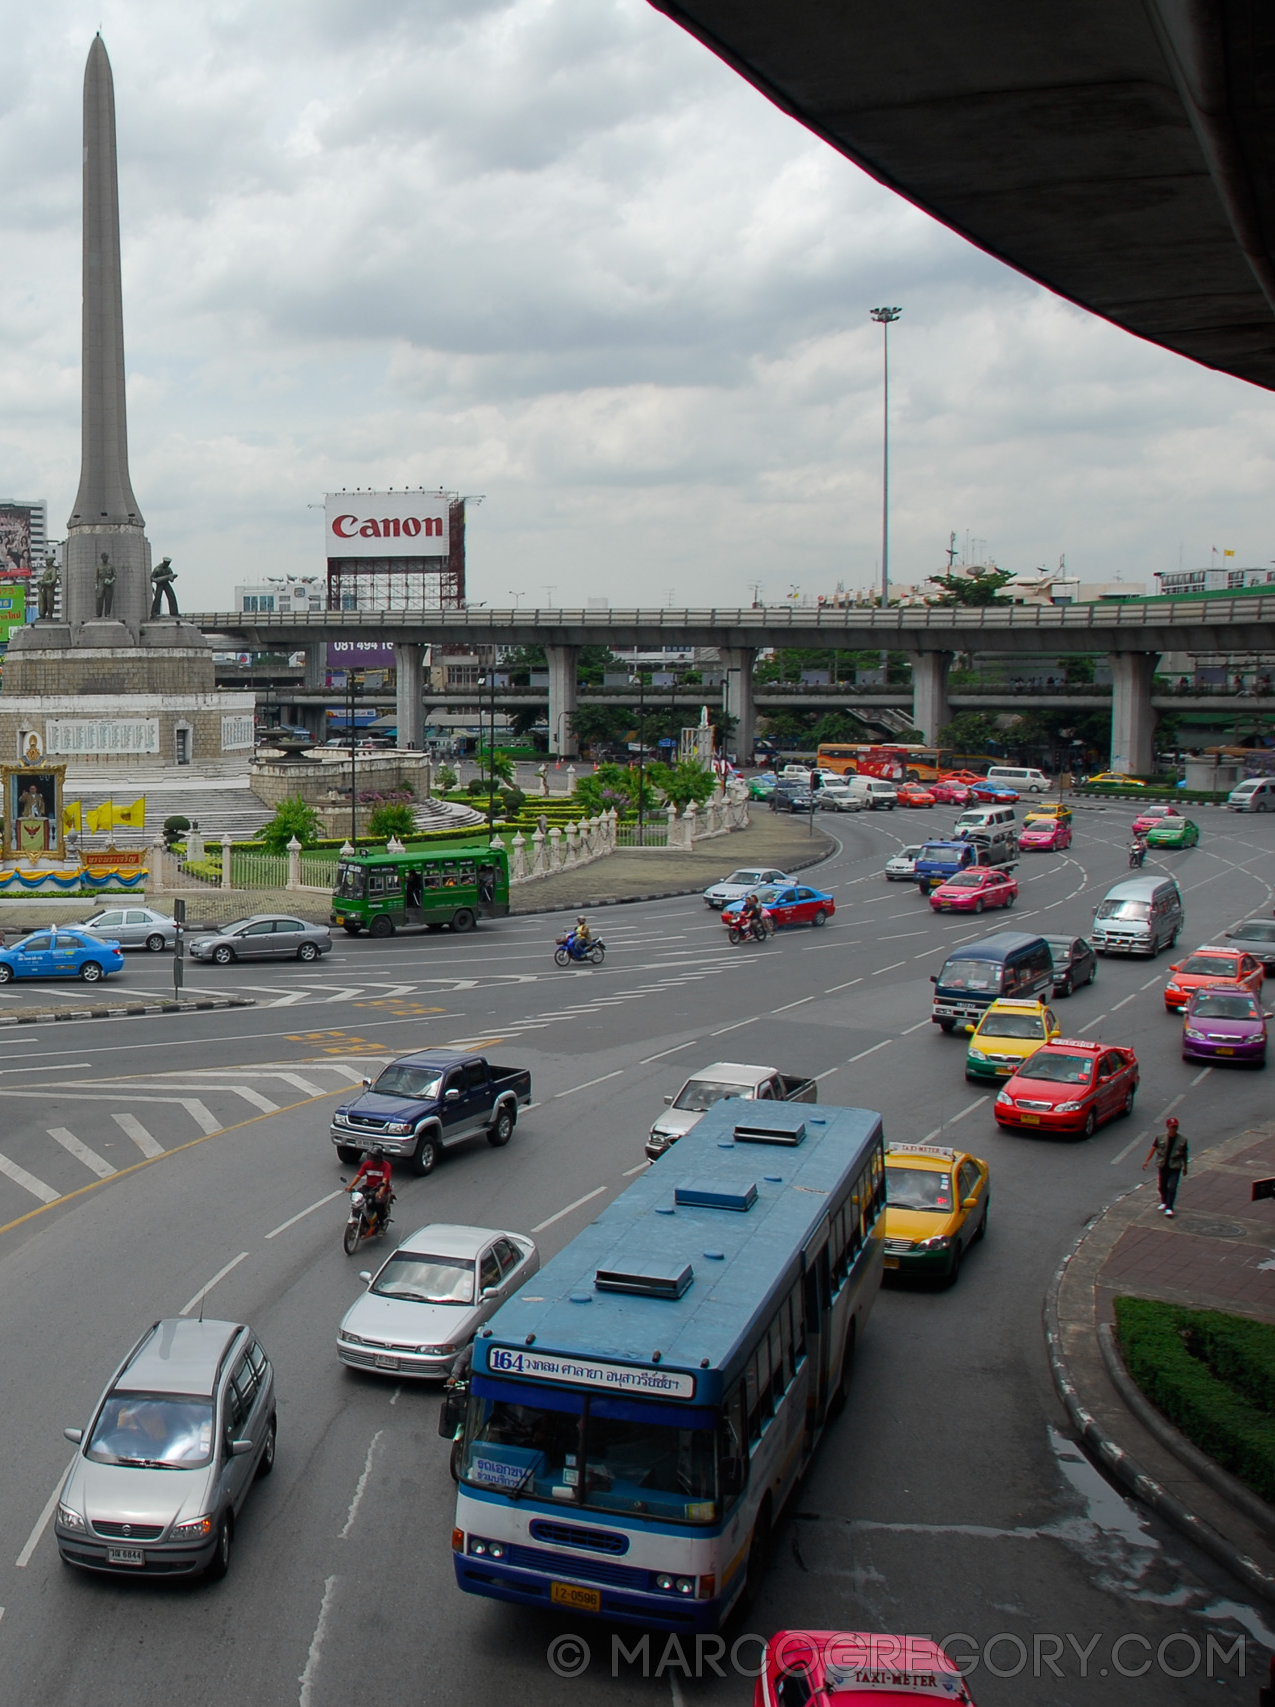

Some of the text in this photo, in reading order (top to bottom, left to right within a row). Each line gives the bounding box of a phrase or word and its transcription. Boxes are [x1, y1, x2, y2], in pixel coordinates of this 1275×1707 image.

[332, 514, 443, 538] Canon
[902, 1145, 940, 1154] TAXI-METER
[491, 1350, 680, 1389] 164 วงกลม ศาลายา อนุสาวรีย์ชัยฯ
[854, 1670, 938, 1688] TAXI-METER
